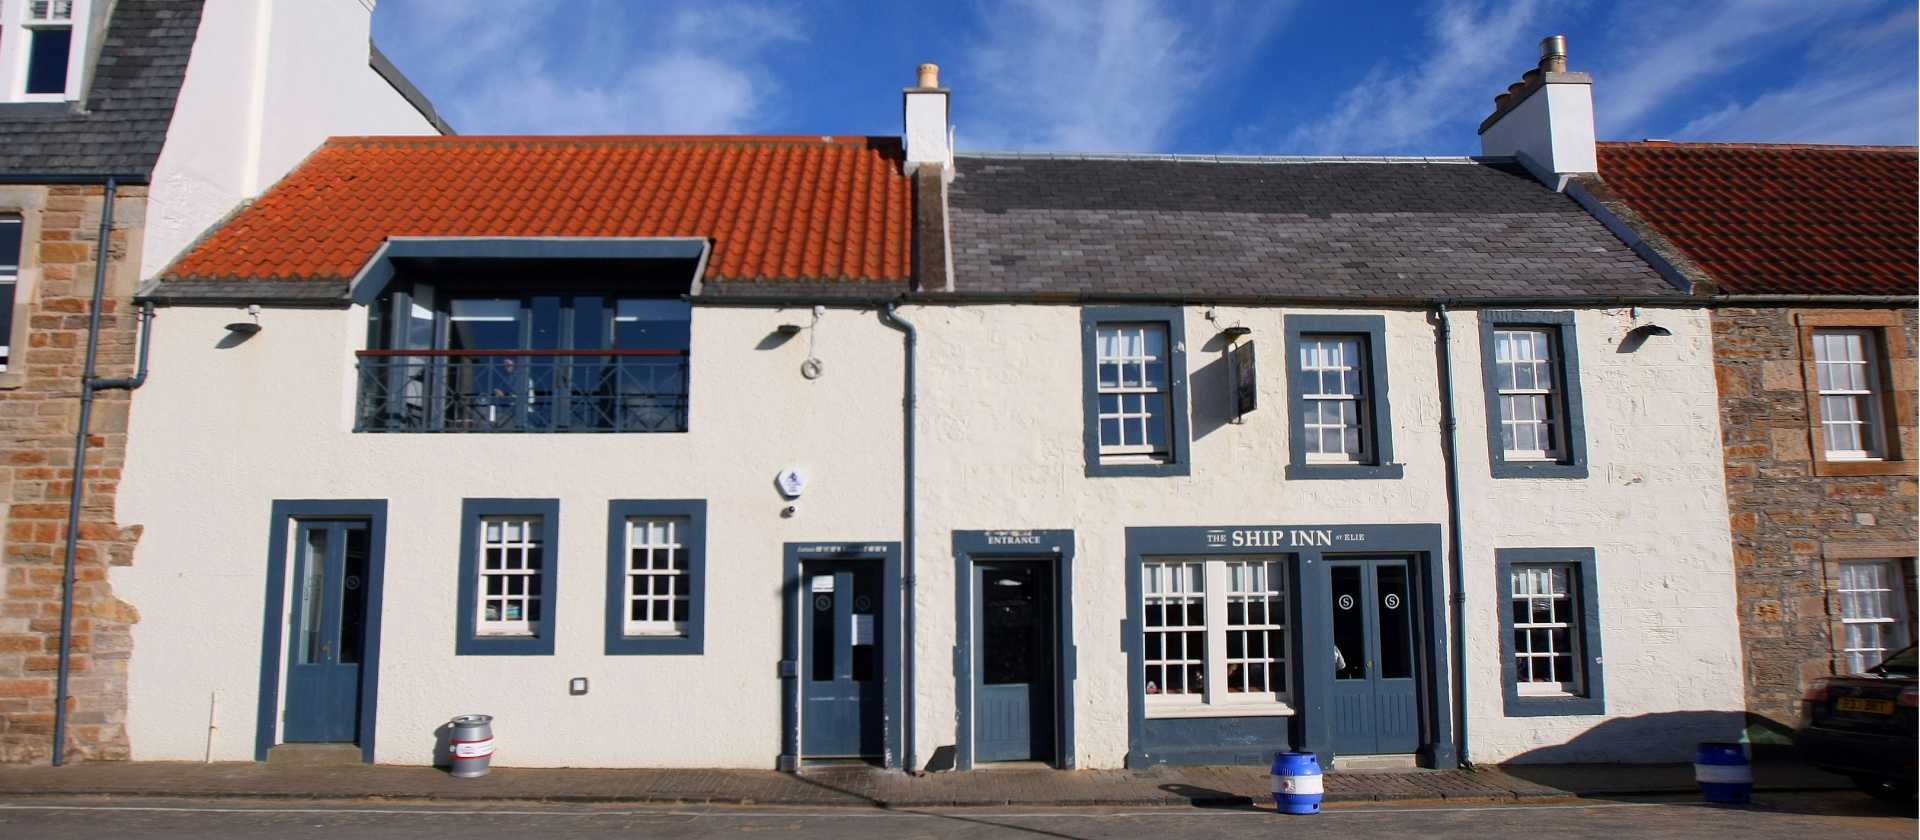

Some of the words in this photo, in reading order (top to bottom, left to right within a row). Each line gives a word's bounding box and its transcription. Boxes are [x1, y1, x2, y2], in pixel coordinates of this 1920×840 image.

[988, 536, 1041, 545] ENTRANCE
[1206, 534, 1227, 543] THE
[1232, 530, 1284, 547] SHIP
[1290, 529, 1332, 547] INN
